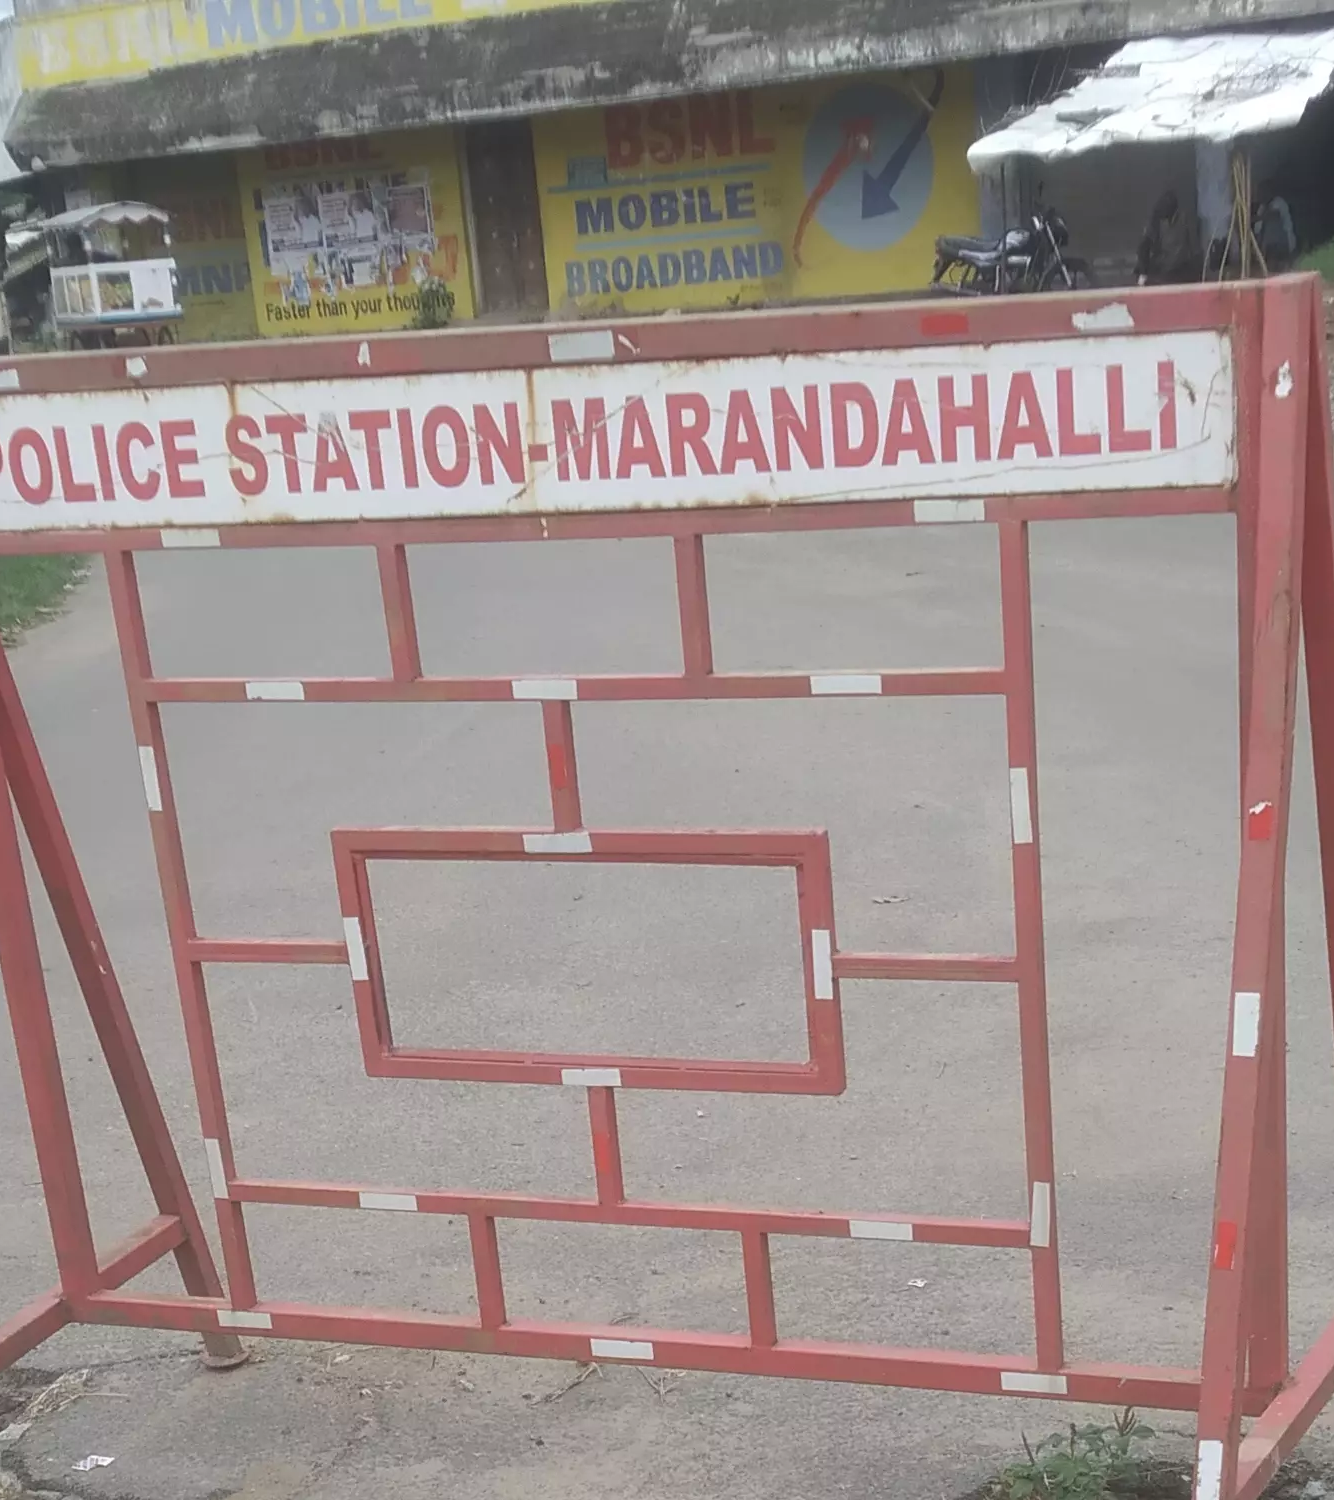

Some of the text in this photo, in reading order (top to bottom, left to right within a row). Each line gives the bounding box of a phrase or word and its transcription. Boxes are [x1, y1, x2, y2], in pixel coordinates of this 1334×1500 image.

[603, 90, 776, 169] BSNL
[574, 181, 757, 236] MOBILE
[564, 240, 785, 298] BROADBAND
[265, 300, 312, 322] Faster
[316, 297, 348, 319] than
[351, 294, 384, 321] your
[224, 360, 1178, 499] STATION-MARANDAHALLI
